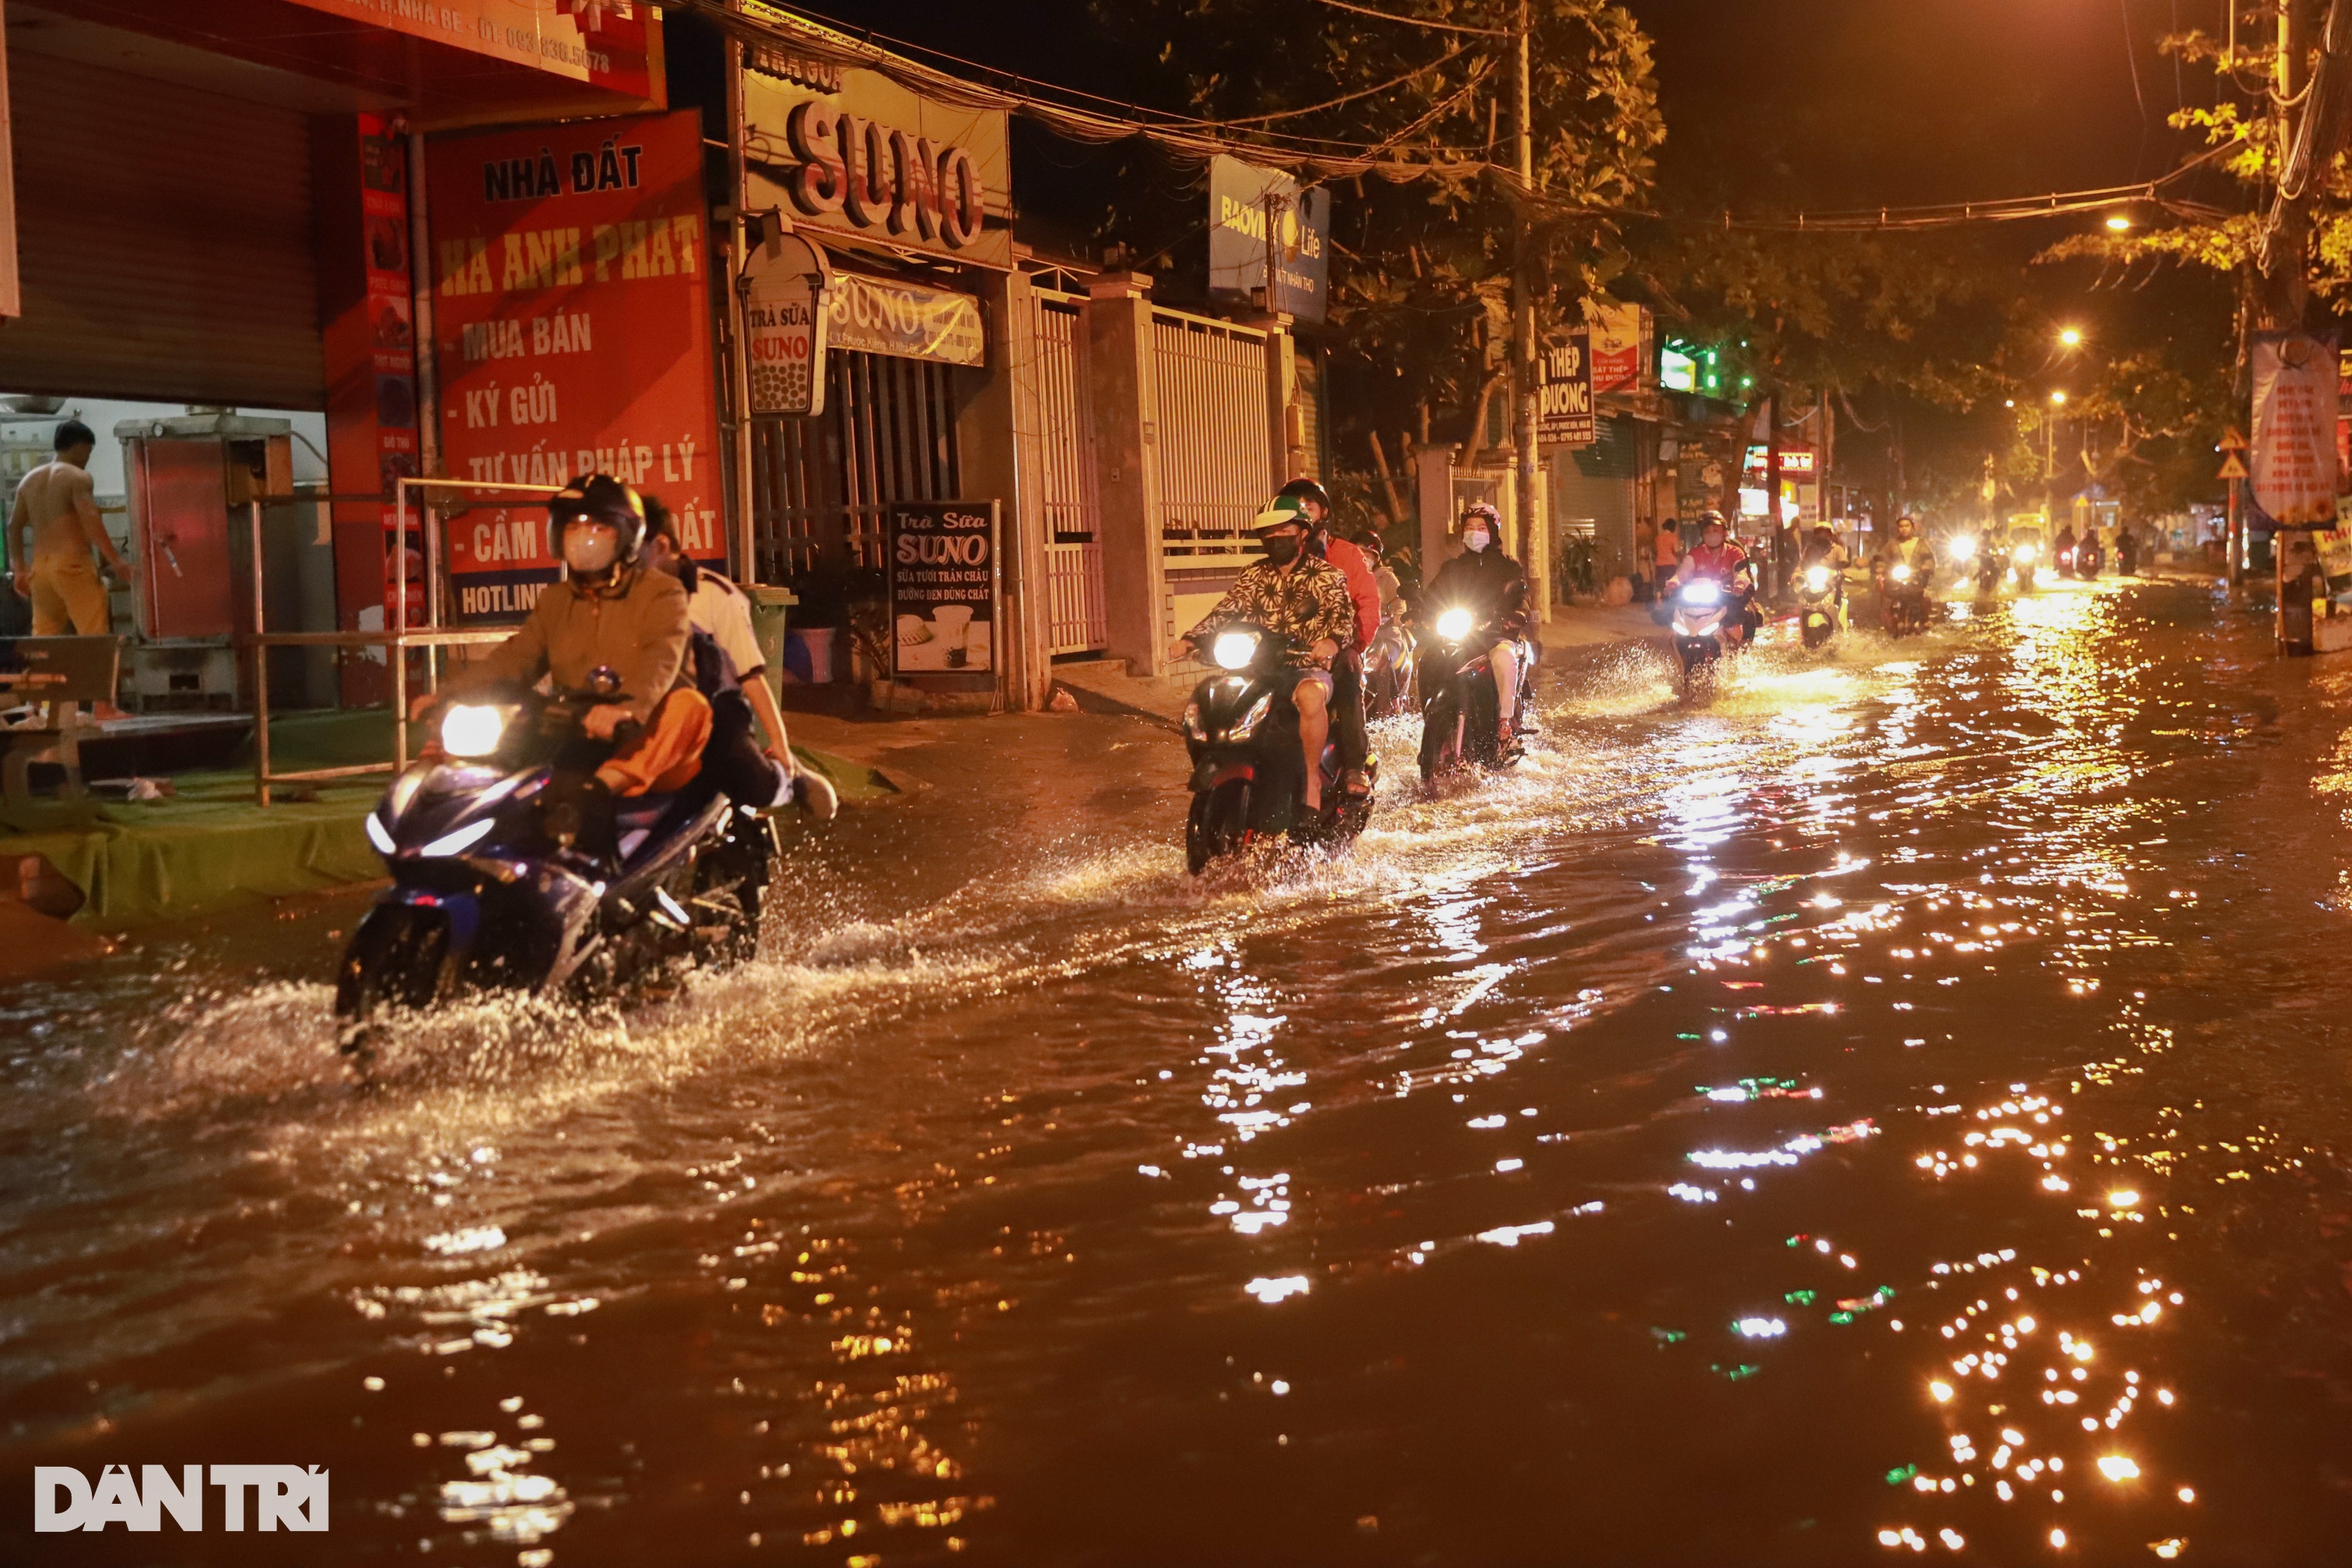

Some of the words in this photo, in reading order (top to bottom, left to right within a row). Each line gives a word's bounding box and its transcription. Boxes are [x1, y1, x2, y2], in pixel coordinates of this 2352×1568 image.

[483, 147, 562, 202] NHÀ
[571, 133, 643, 194] ĐẤT
[789, 101, 983, 248] SUNO
[503, 228, 583, 290] ANH
[593, 204, 698, 282] PHÁT
[1301, 225, 1320, 259] Life
[464, 319, 525, 361] MUA
[533, 306, 591, 355] BÁN
[749, 304, 777, 327] TRÀ
[780, 302, 810, 326] SỮA
[833, 282, 918, 335] SUNO
[752, 336, 808, 361] SUNO
[466, 380, 501, 428] KÝ
[510, 372, 557, 425] GỬI
[469, 451, 505, 495] TƯ
[511, 439, 569, 486] VẤN
[577, 438, 653, 485] PHÁP
[663, 434, 695, 482] LÝ
[473, 509, 537, 563] CẦM
[676, 497, 716, 550] ẤT
[897, 512, 934, 530] Trà
[943, 512, 988, 529] Sữa
[896, 533, 988, 566] SUNO
[897, 569, 915, 583] SỮA
[938, 568, 963, 583] TRÂN
[964, 567, 988, 582] CHÂU
[944, 586, 967, 600] ĐÚNG
[968, 583, 989, 600] CHẤT
